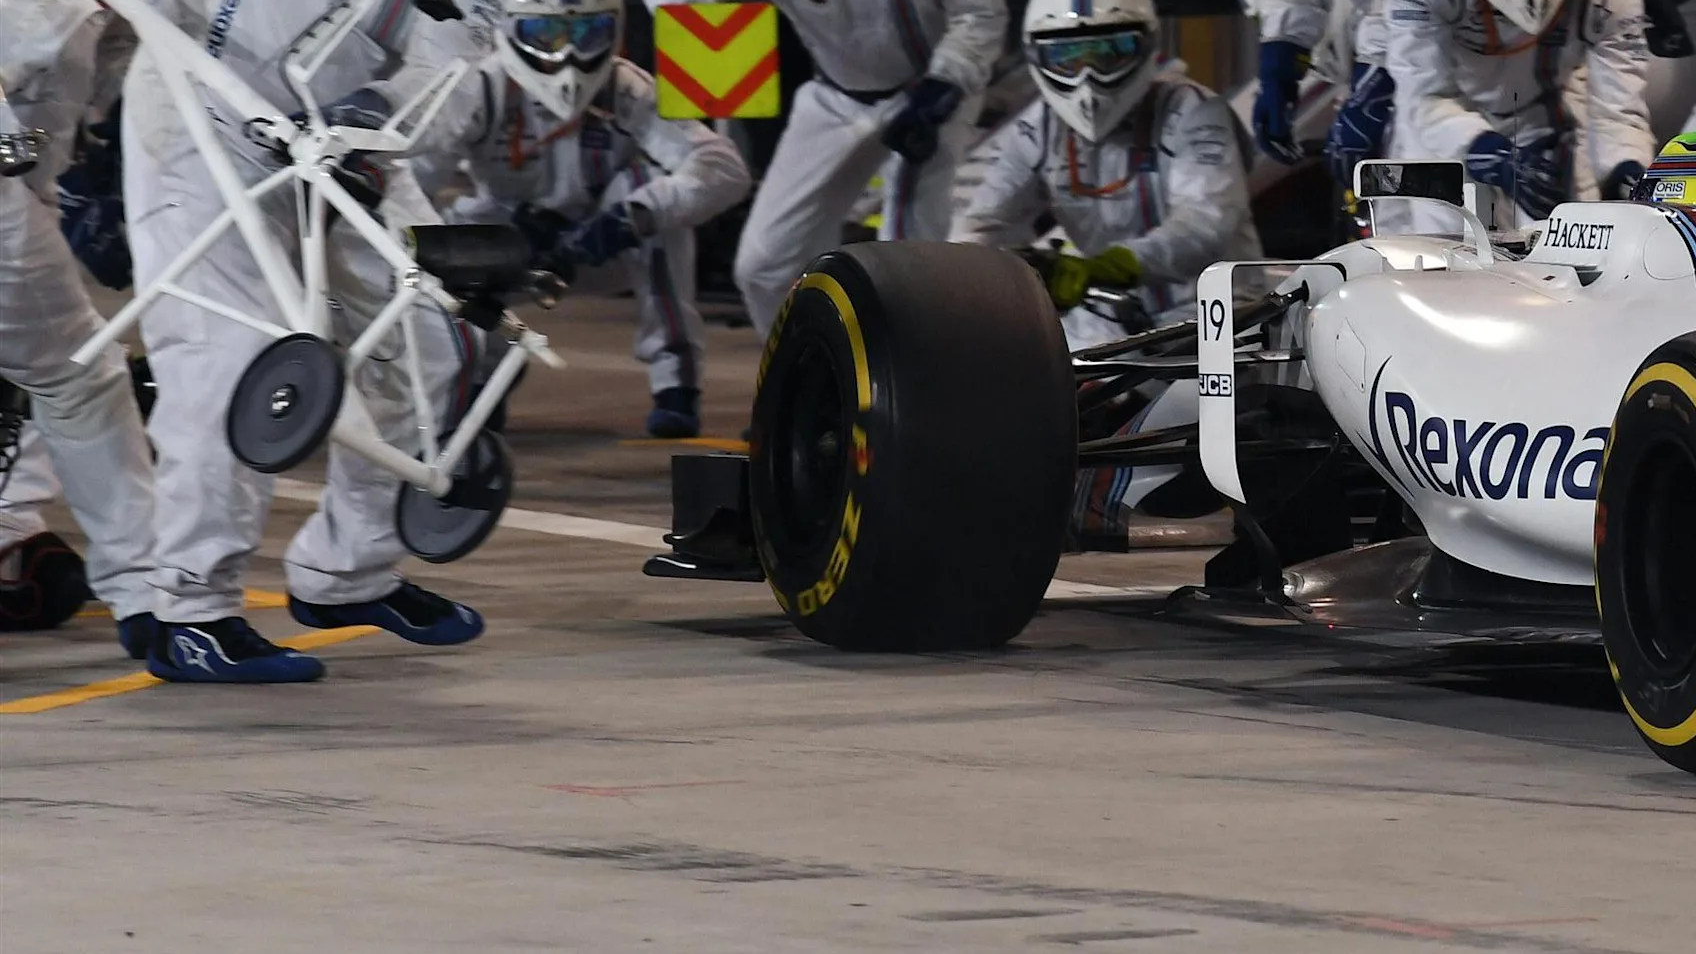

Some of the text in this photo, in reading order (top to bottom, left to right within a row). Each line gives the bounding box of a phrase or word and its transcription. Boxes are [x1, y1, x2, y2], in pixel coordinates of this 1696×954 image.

[1656, 182, 1684, 192] ORIS
[1543, 217, 1615, 251] HACKETT
[1200, 298, 1226, 341] 19
[1199, 374, 1232, 396] JCB
[1383, 391, 1613, 501] Rexona
